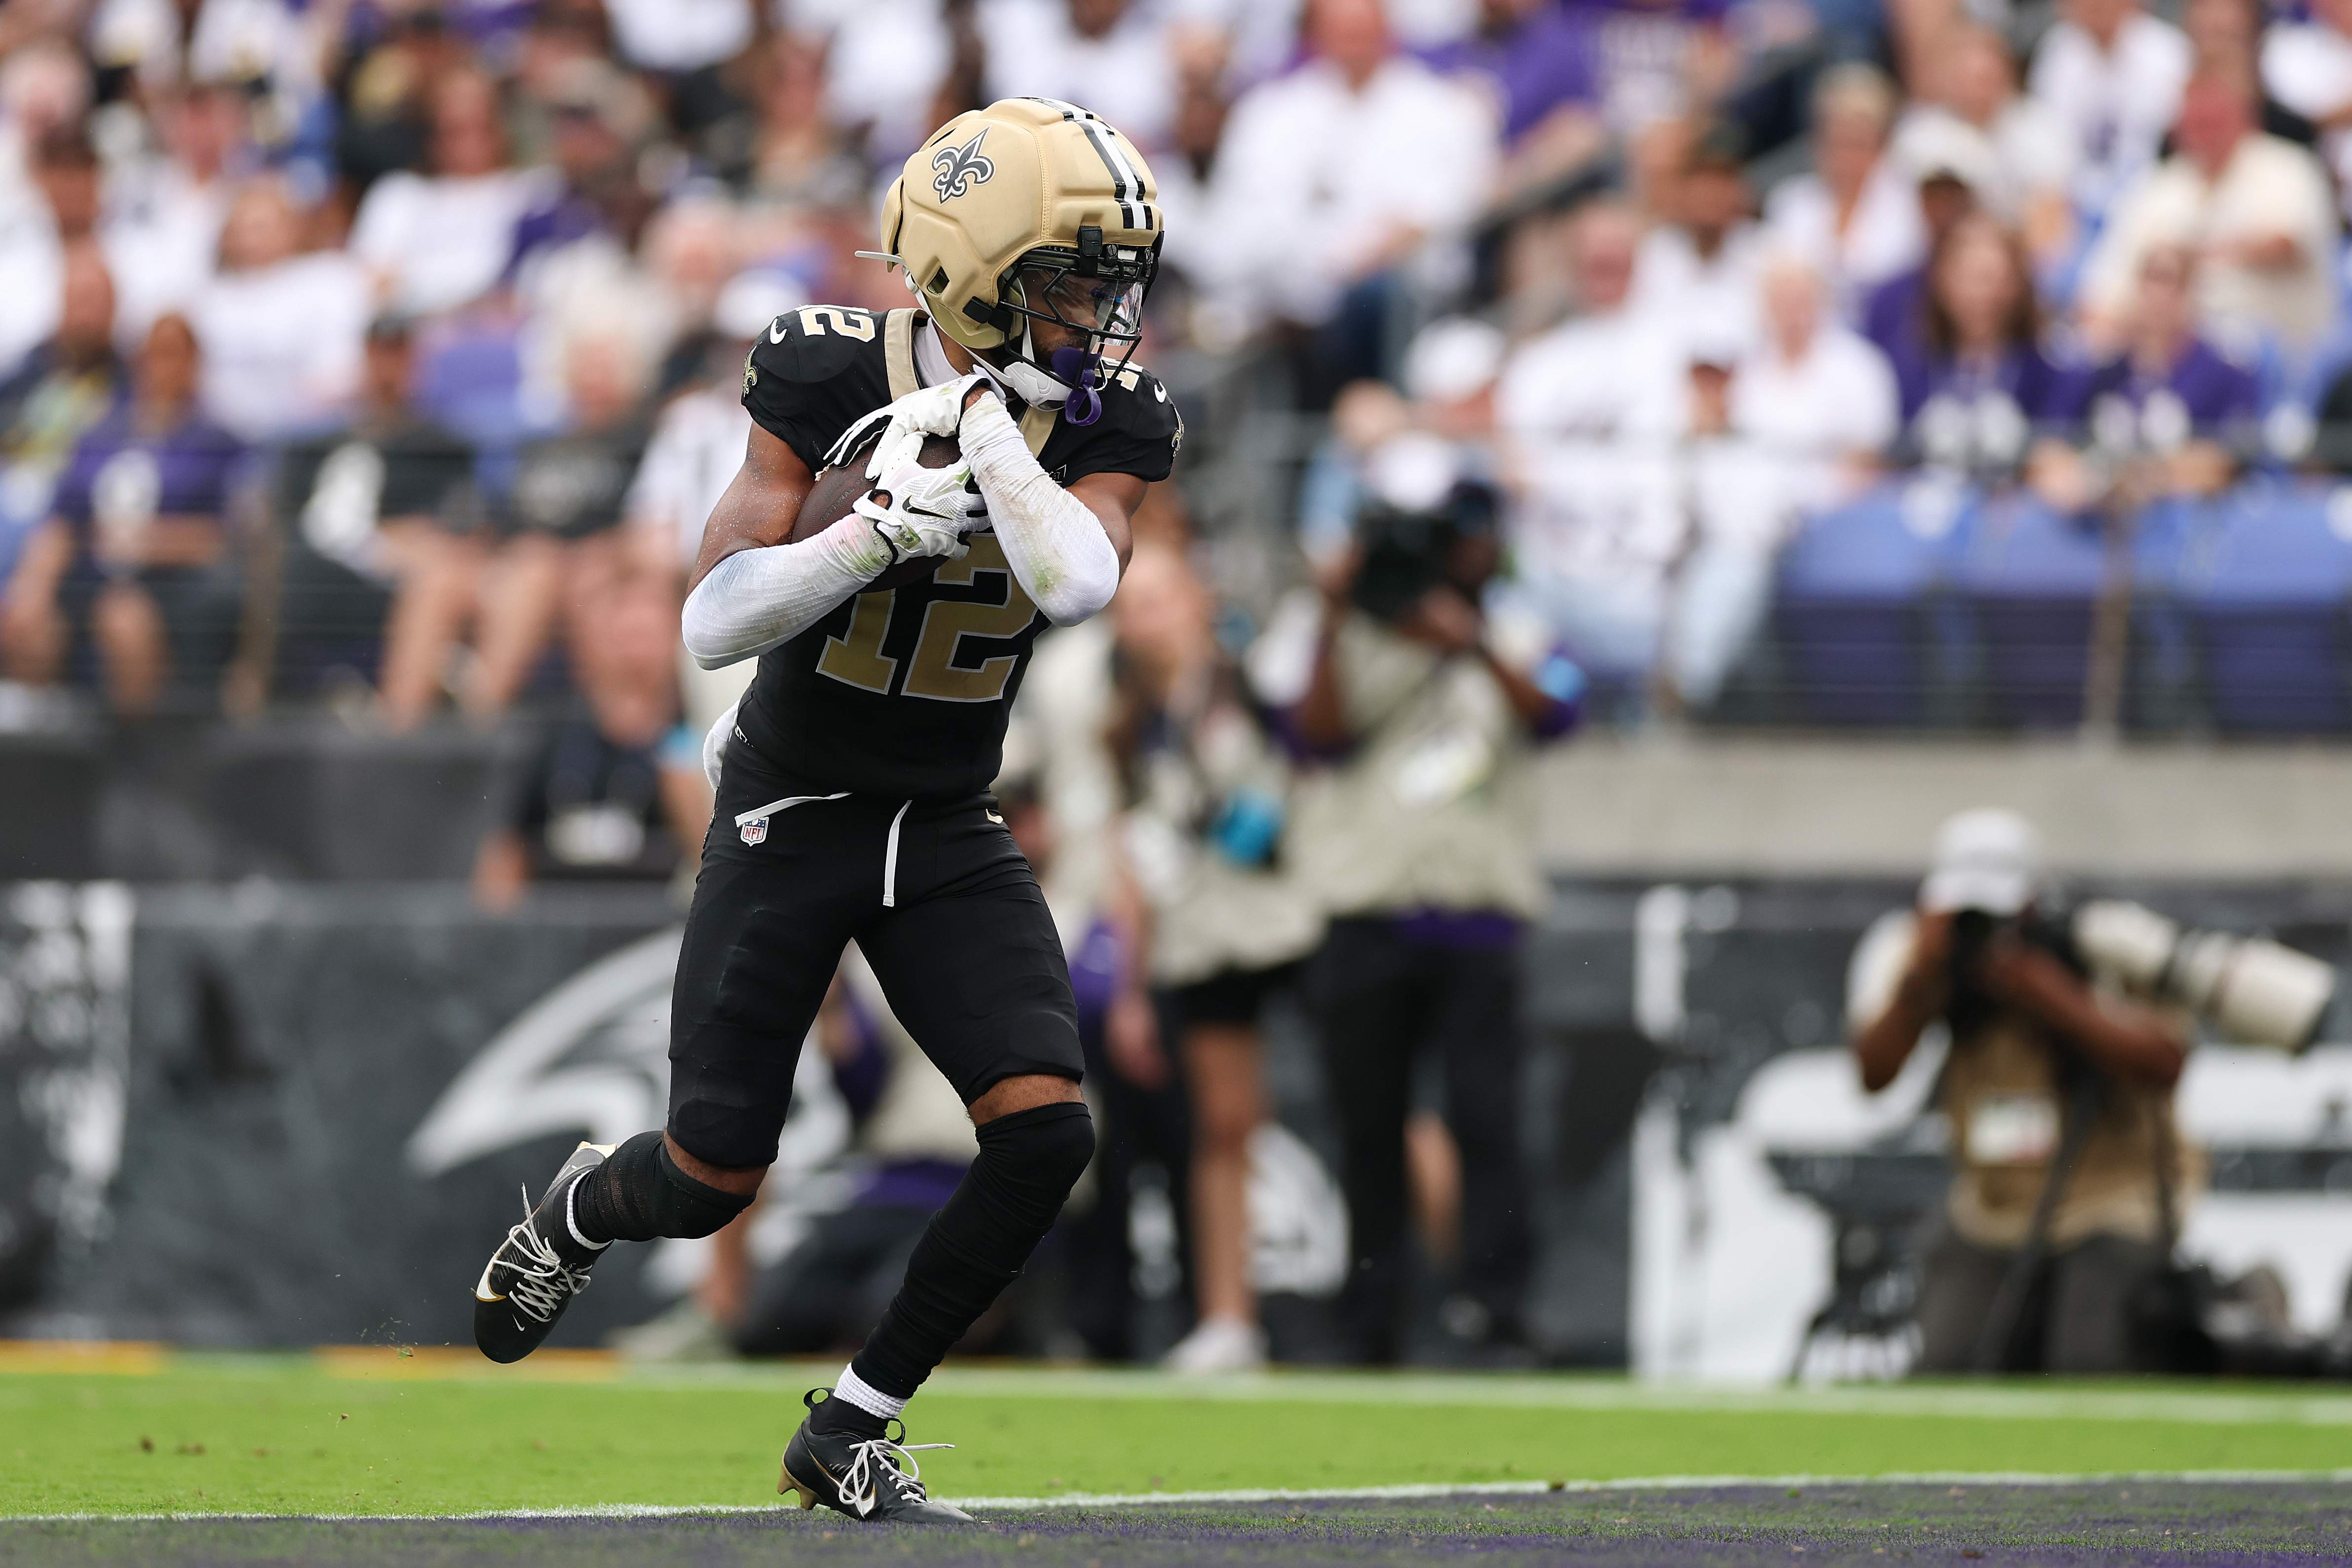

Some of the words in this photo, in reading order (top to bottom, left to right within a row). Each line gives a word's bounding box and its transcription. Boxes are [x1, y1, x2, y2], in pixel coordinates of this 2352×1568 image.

[795, 304, 876, 343] 2
[815, 532, 1039, 703] 12
[744, 827, 762, 839] NFL
